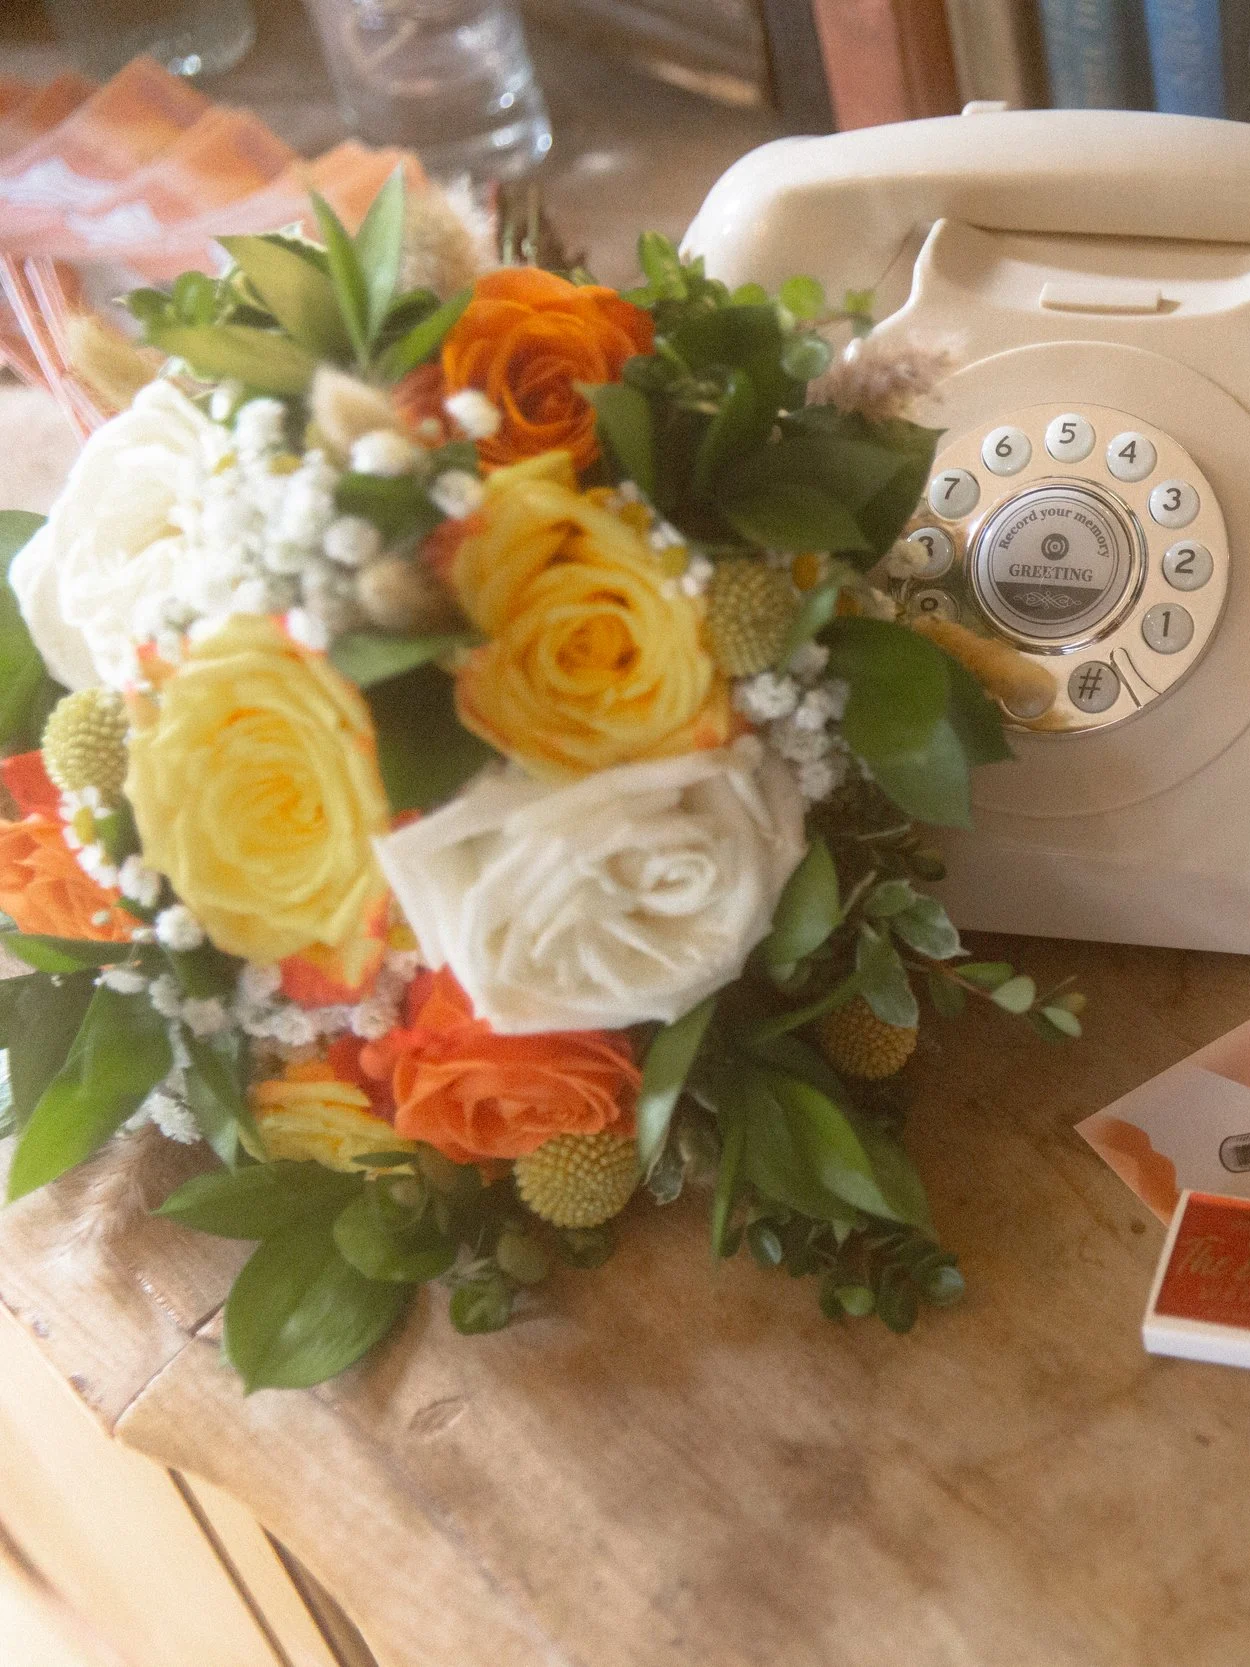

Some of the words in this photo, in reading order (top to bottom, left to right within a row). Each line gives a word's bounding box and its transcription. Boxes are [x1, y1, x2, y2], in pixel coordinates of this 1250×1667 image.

[1059, 423, 1077, 444] 5
[995, 435, 1012, 457] 6
[1119, 441, 1136, 463] 4
[943, 478, 960, 500] 7
[1163, 487, 1181, 511] 3
[999, 510, 1038, 549] Record
[1040, 507, 1073, 521] your
[1073, 511, 1110, 559] memory
[1008, 563, 1093, 582] GREETING
[1175, 549, 1195, 574] 2
[1162, 611, 1171, 637] 1
[1078, 667, 1102, 700] #
